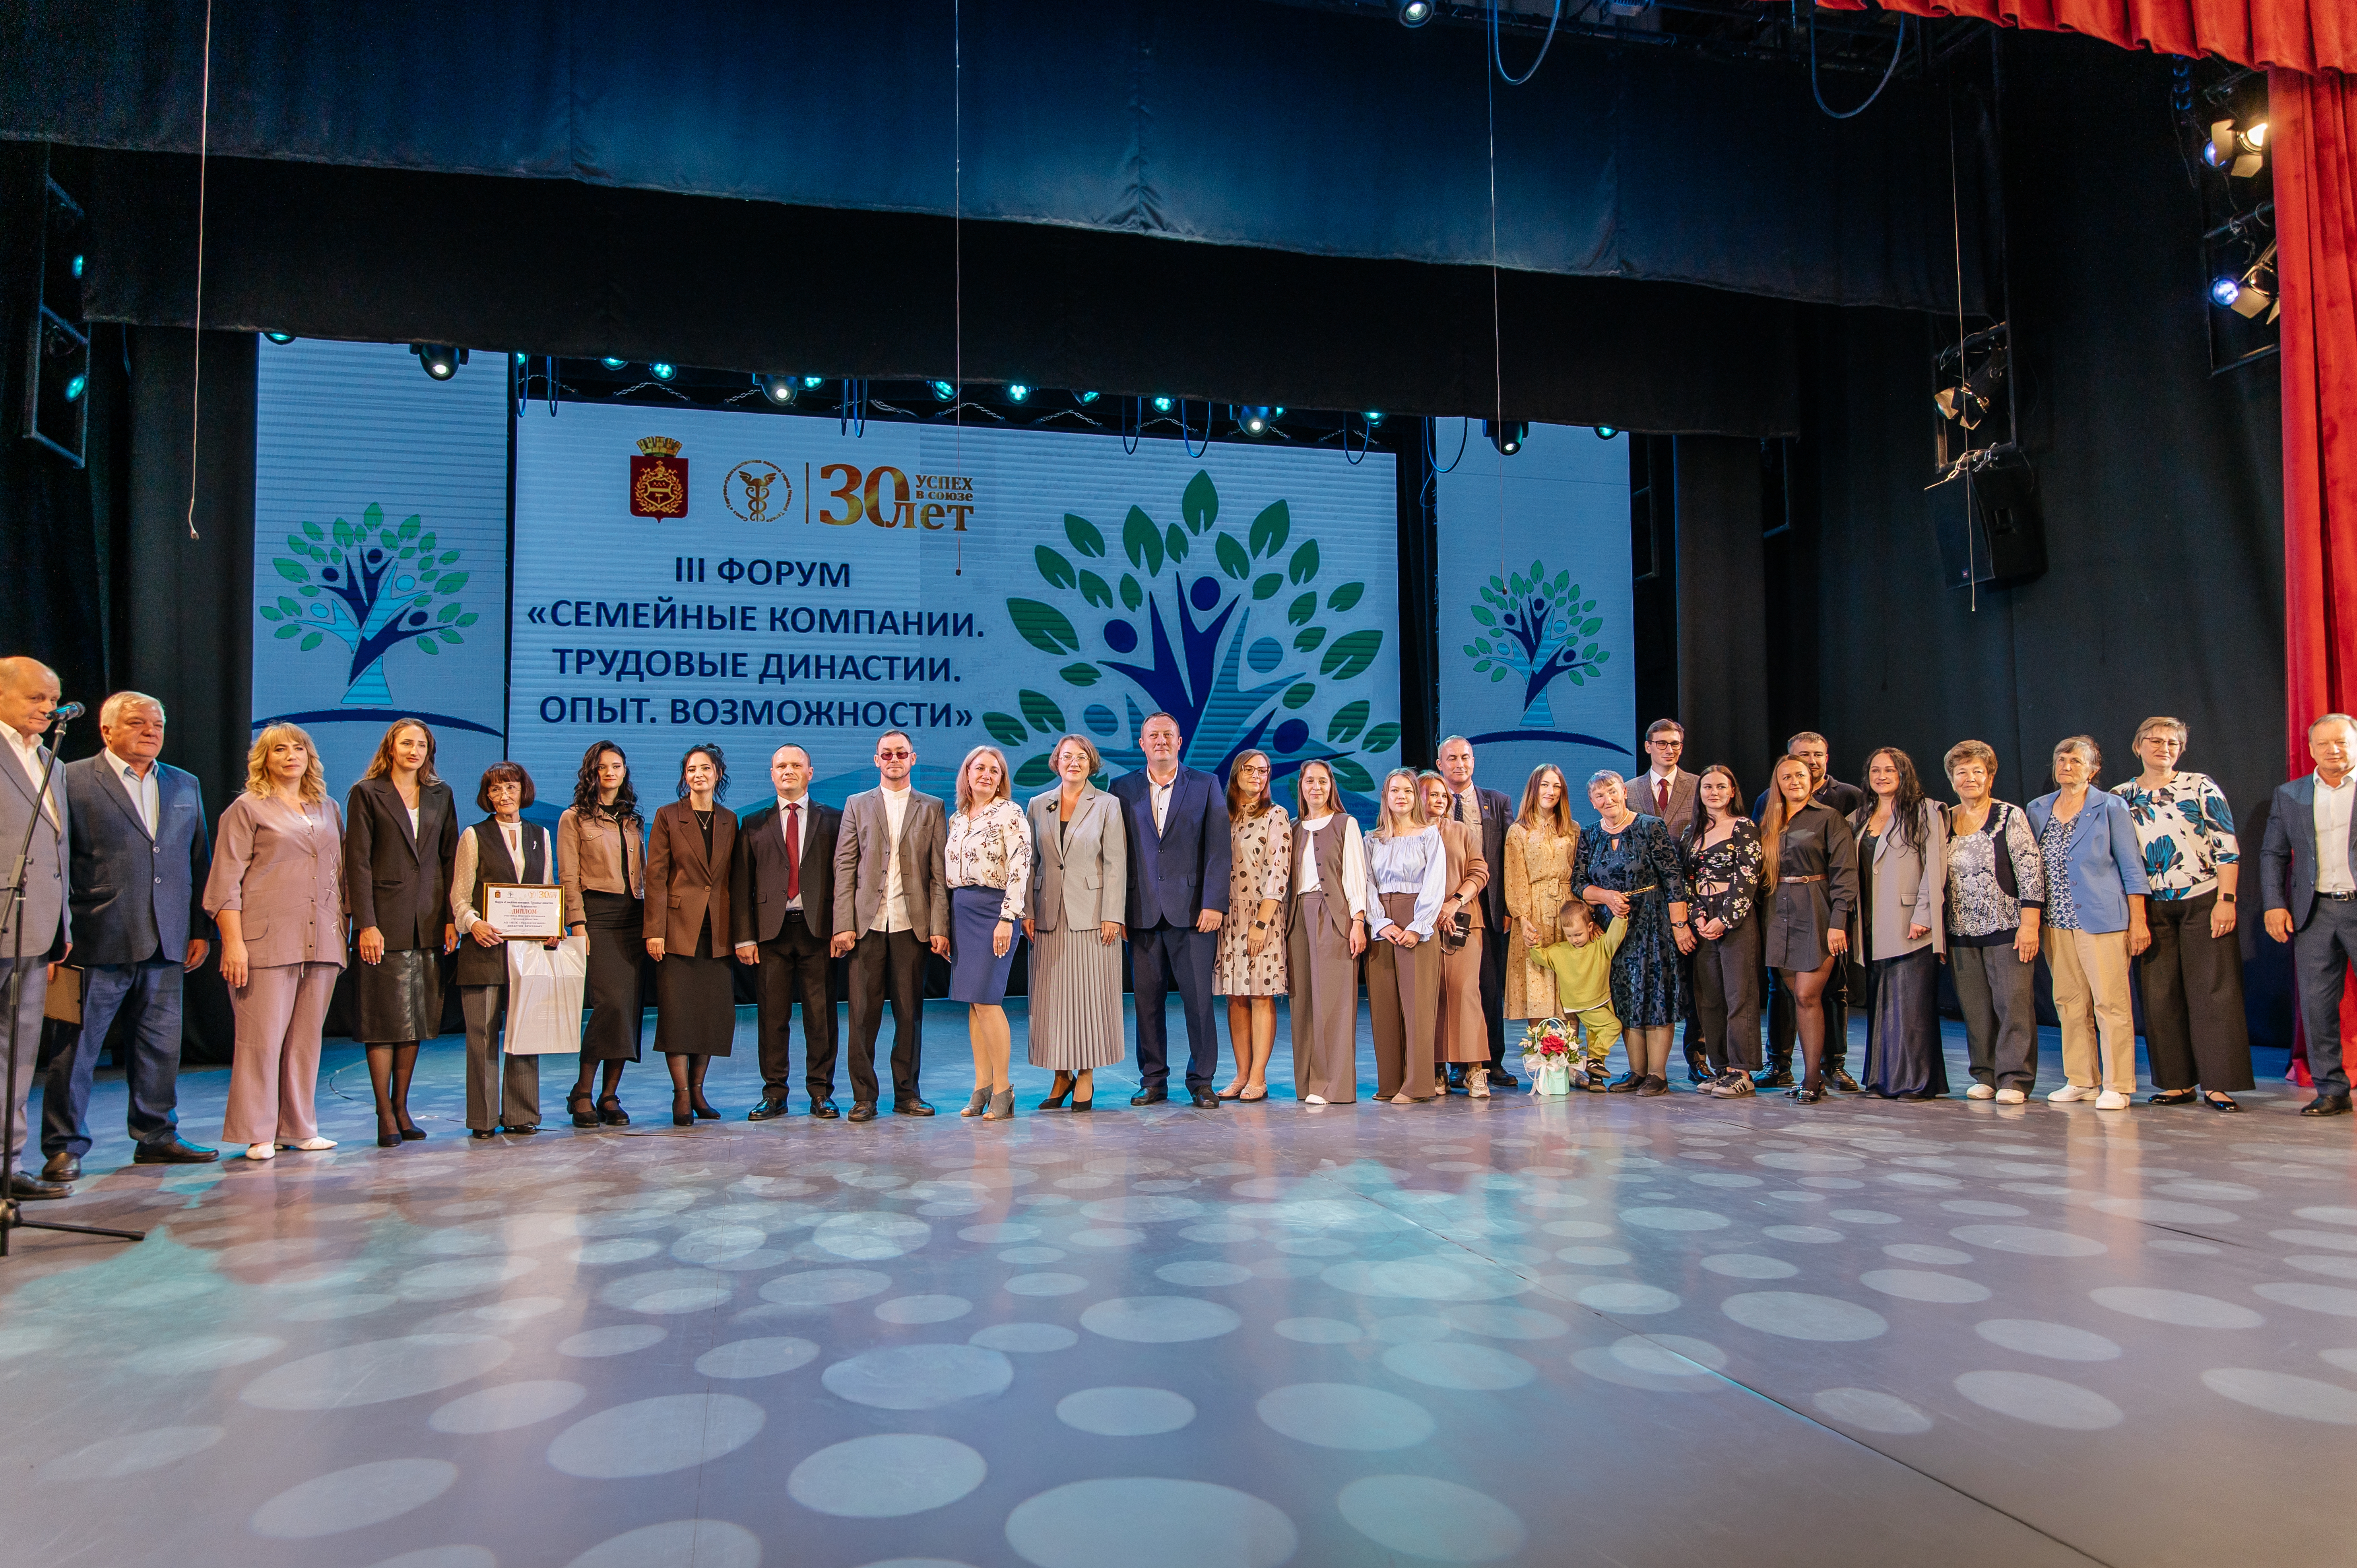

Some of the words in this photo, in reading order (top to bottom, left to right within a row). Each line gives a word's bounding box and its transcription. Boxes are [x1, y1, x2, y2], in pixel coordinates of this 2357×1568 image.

[820, 463, 910, 527] 30
[915, 475, 974, 491] УСПЕХ
[916, 490, 924, 499] в
[928, 491, 973, 502] союзе
[885, 502, 974, 531] лет
[676, 557, 705, 583] III
[717, 557, 850, 587] ФОРУМ
[528, 596, 757, 631] «СЕМЕЙНЫЕ
[770, 607, 984, 638] КОМПАНИИ.
[552, 648, 748, 682] ТРУДОВЫЕ
[759, 653, 960, 685] ДИНАСТИИ.
[540, 696, 656, 723] ОПЫТ.
[671, 698, 973, 728] ВОЗМОЖНОСТИ»
